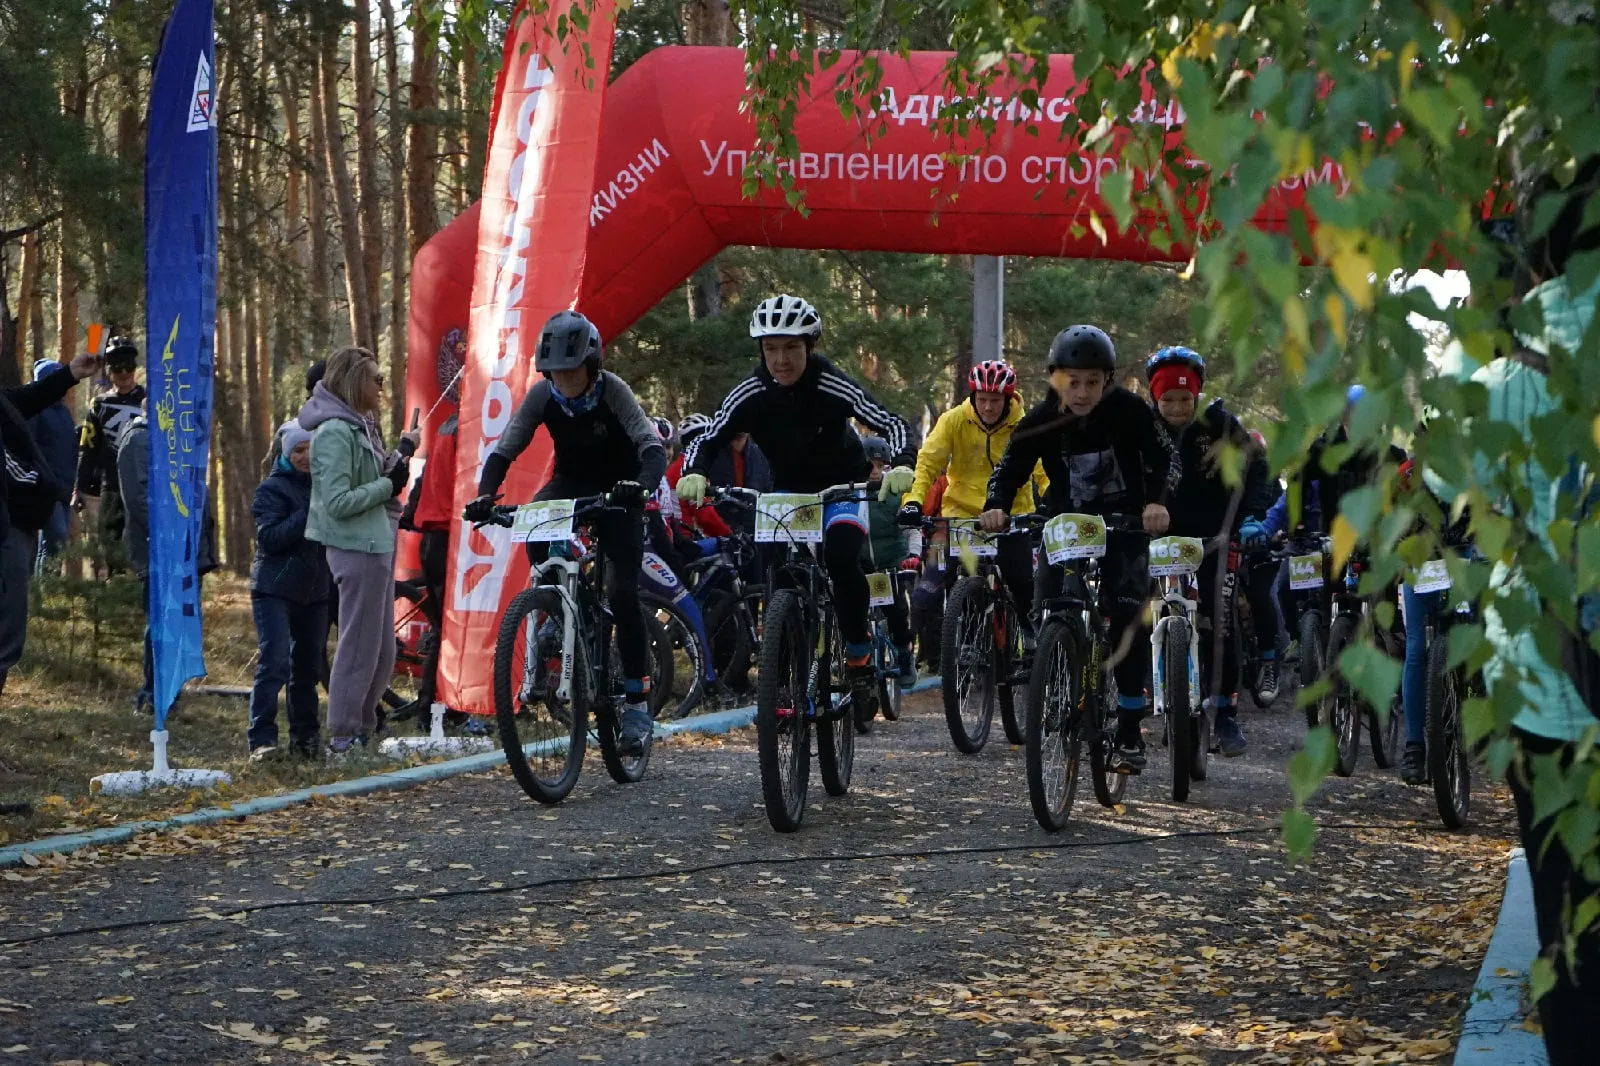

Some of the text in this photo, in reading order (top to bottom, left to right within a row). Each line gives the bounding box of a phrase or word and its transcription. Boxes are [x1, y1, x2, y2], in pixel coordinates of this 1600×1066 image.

[699, 139, 945, 182] Упавление
[1045, 521, 1079, 545] 162
[1149, 542, 1180, 558] 166
